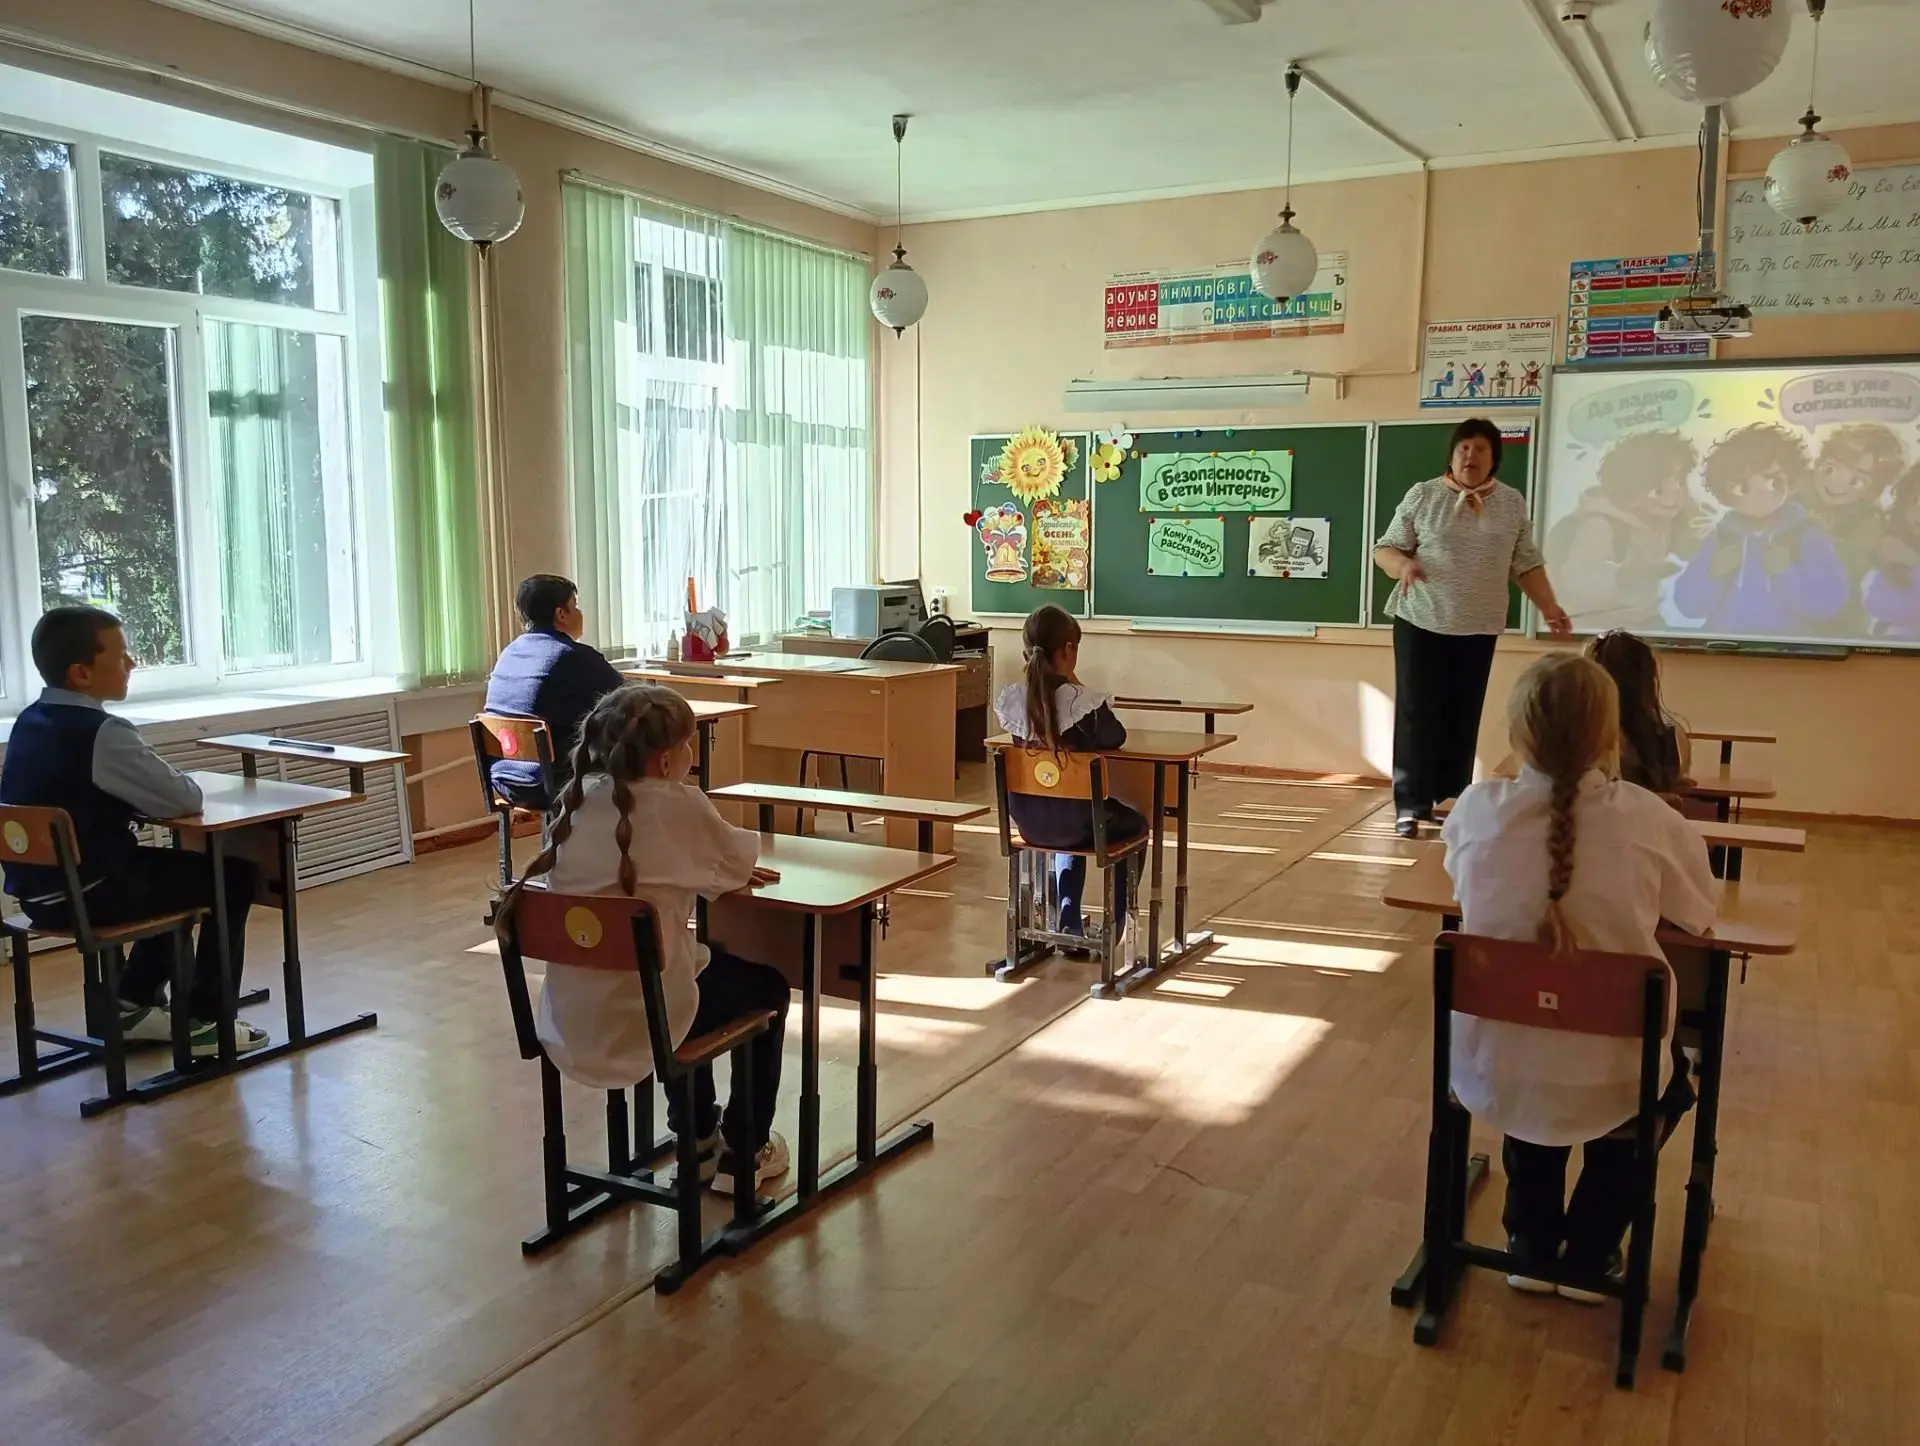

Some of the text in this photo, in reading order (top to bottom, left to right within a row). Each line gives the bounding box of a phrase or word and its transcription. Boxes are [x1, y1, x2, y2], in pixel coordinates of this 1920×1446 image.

[1622, 257, 1667, 268] ПАДЕЖИ
[1428, 321, 1551, 333] ПРАВИЛА СИДЕНИЯ ЗА ПАРТОЙ
[1813, 379, 1846, 395] Все
[1161, 467, 1271, 487] Безопасность
[1157, 481, 1280, 501] в сети Интернет
[1043, 530, 1075, 539] ОСЕНЬ
[1163, 526, 1217, 557] Кому я могу
[1160, 538, 1217, 565] рассказать?
